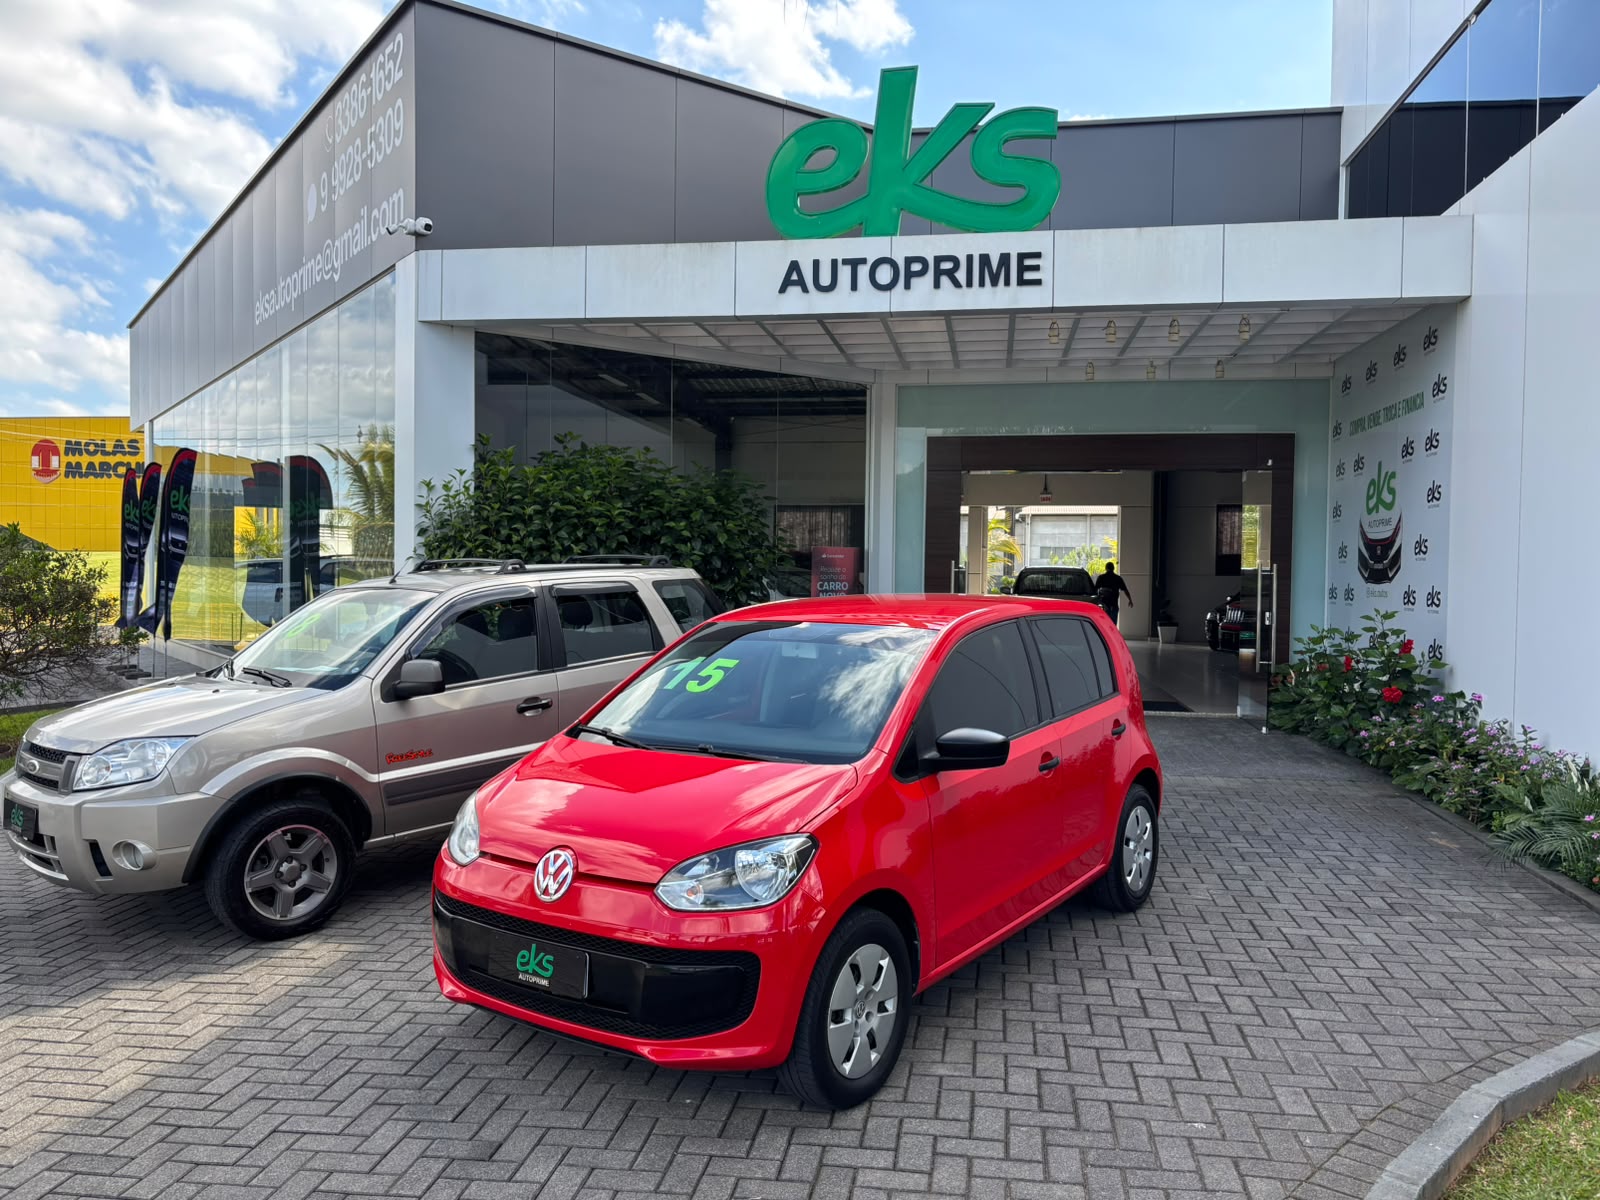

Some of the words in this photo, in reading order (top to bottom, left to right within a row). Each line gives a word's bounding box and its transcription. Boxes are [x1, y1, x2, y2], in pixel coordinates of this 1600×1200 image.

[335, 33, 403, 143] 3386-1652
[321, 171, 328, 212] 9
[332, 98, 404, 201] 9928-5309
[766, 65, 1061, 240] eks
[255, 188, 404, 325] eksautoprime@gmail.com
[778, 252, 1042, 294] AUTOPRIME
[1432, 373, 1447, 398] eks
[64, 439, 140, 457] MOLAS
[1402, 436, 1414, 459] eks
[1425, 428, 1439, 452] eks
[1366, 461, 1396, 515] eks
[1427, 480, 1441, 503] eks
[1414, 533, 1428, 556] eks
[817, 581, 849, 591] CARRO
[1403, 584, 1416, 606] eks
[1426, 585, 1441, 608] eks
[664, 656, 740, 693] 15
[517, 943, 554, 977] eks
[518, 972, 550, 987] AUTOPRIME
